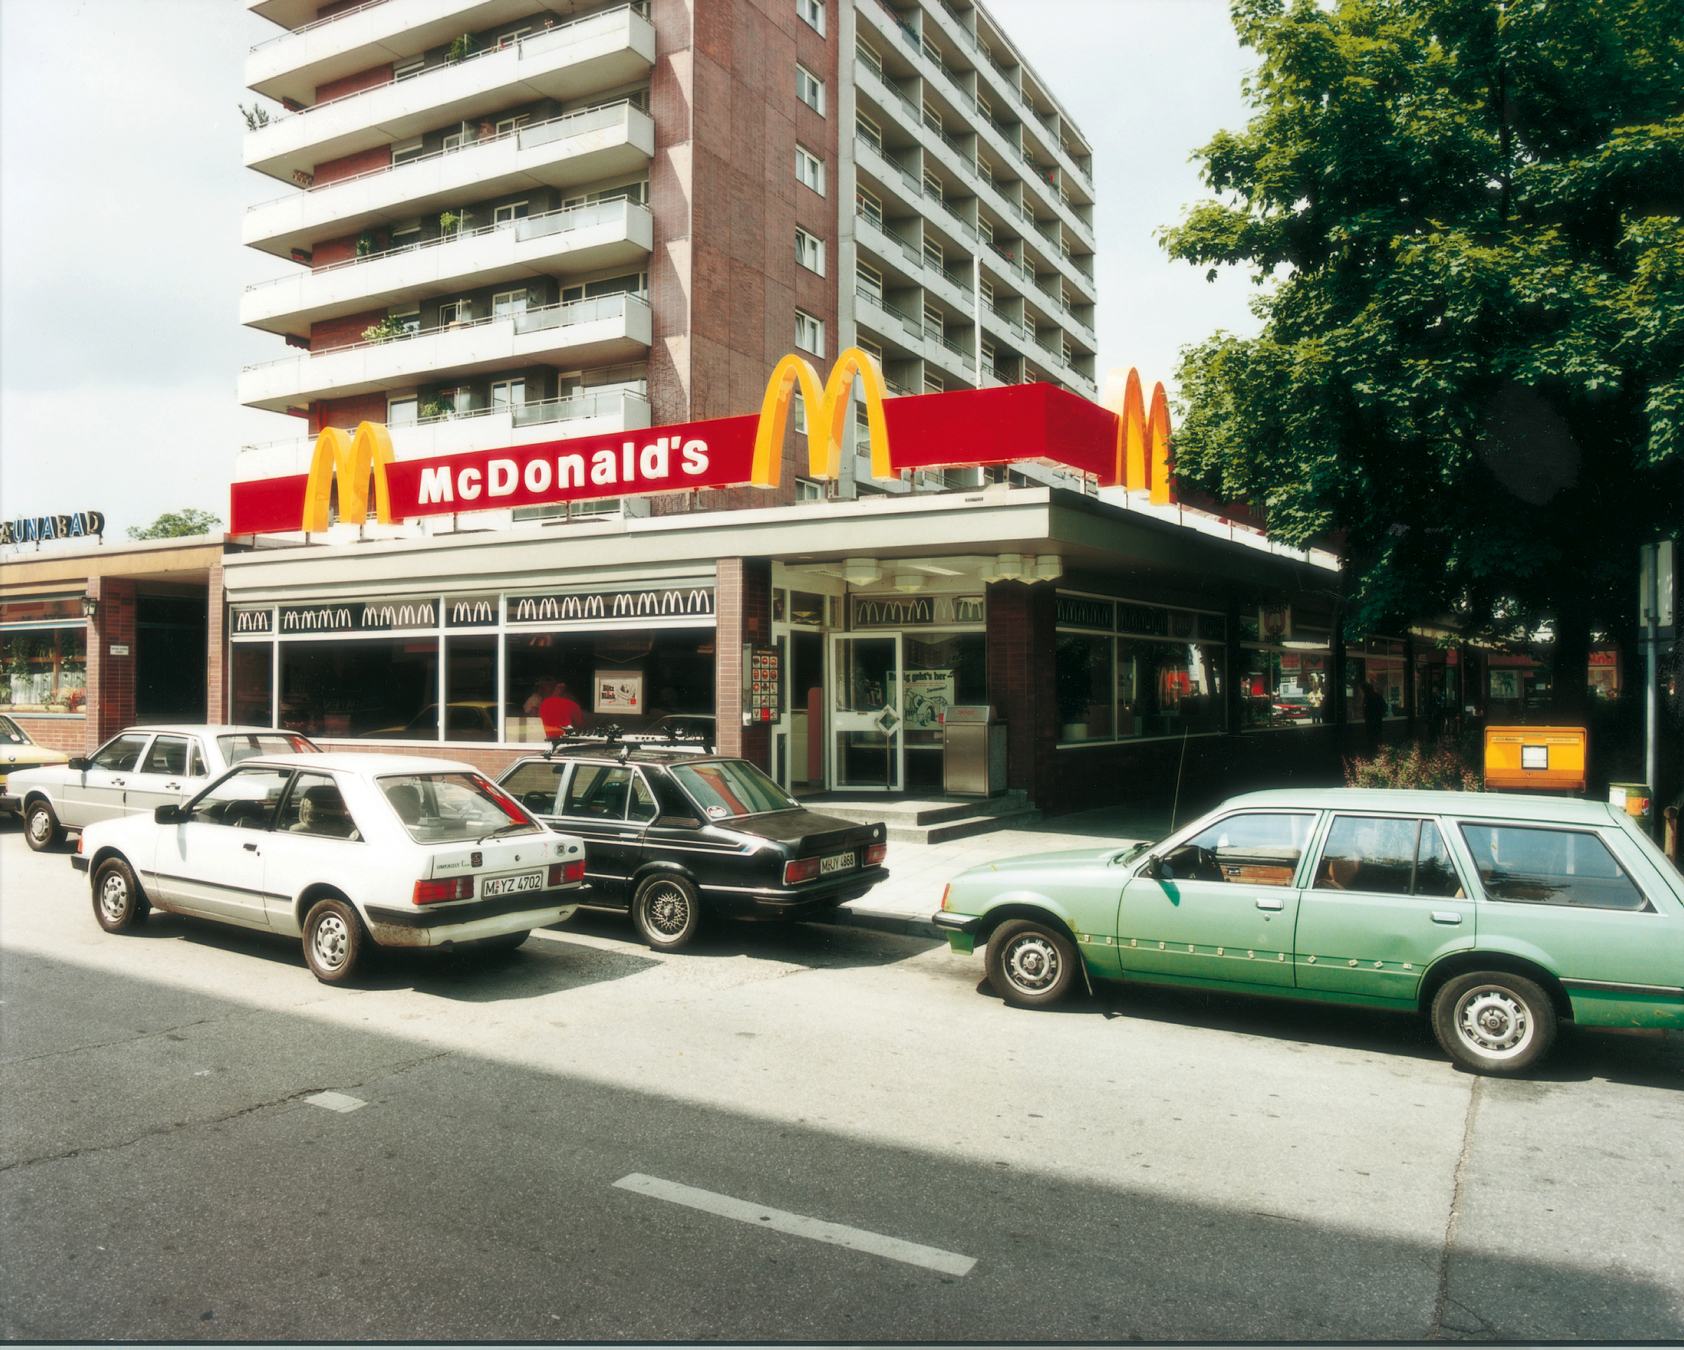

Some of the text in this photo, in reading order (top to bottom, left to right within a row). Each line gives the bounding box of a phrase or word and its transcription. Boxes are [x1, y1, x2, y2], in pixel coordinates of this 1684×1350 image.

[418, 436, 709, 504] McDonald's
[0, 511, 105, 545] AUNABAD
[517, 875, 541, 890] 4702
